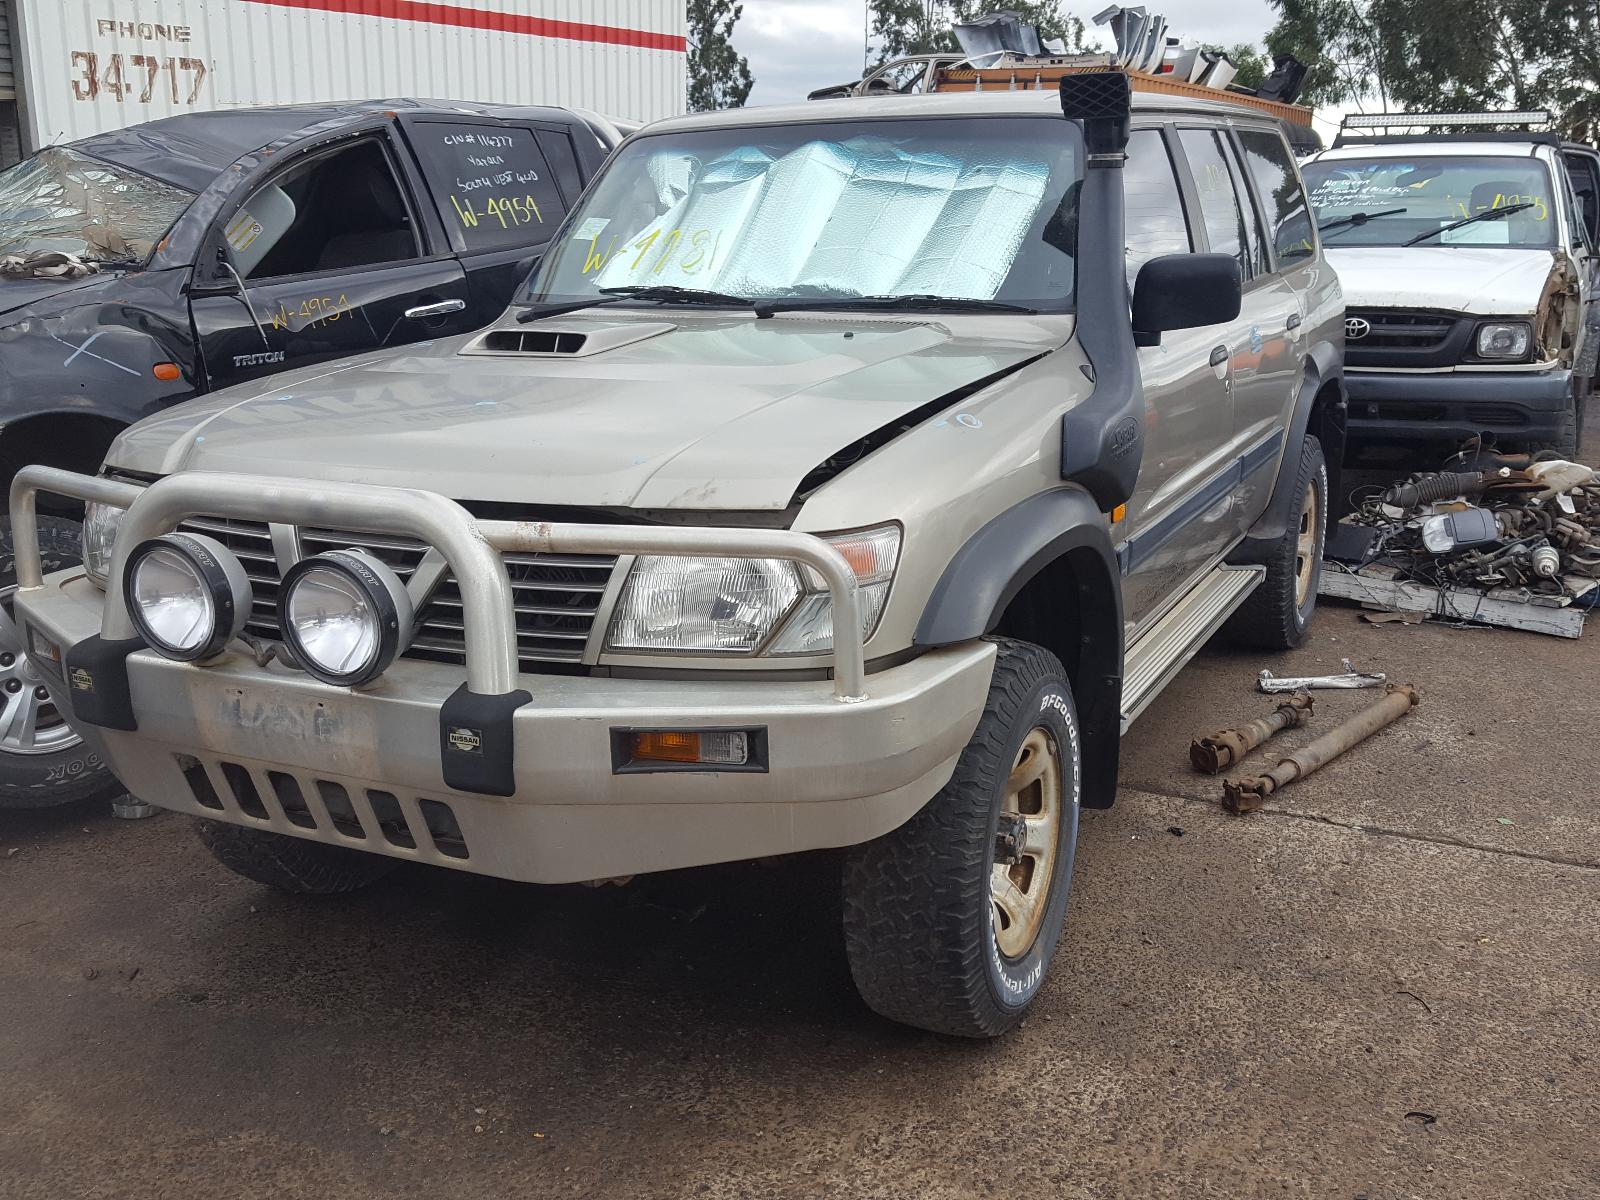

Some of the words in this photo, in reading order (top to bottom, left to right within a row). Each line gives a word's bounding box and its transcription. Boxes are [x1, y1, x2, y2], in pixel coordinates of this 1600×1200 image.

[97, 19, 191, 43] PHONE
[71, 51, 207, 104] 34717
[450, 195, 544, 229] W-4954
[233, 351, 285, 367] TRITON
[450, 734, 480, 746] NISSAN
